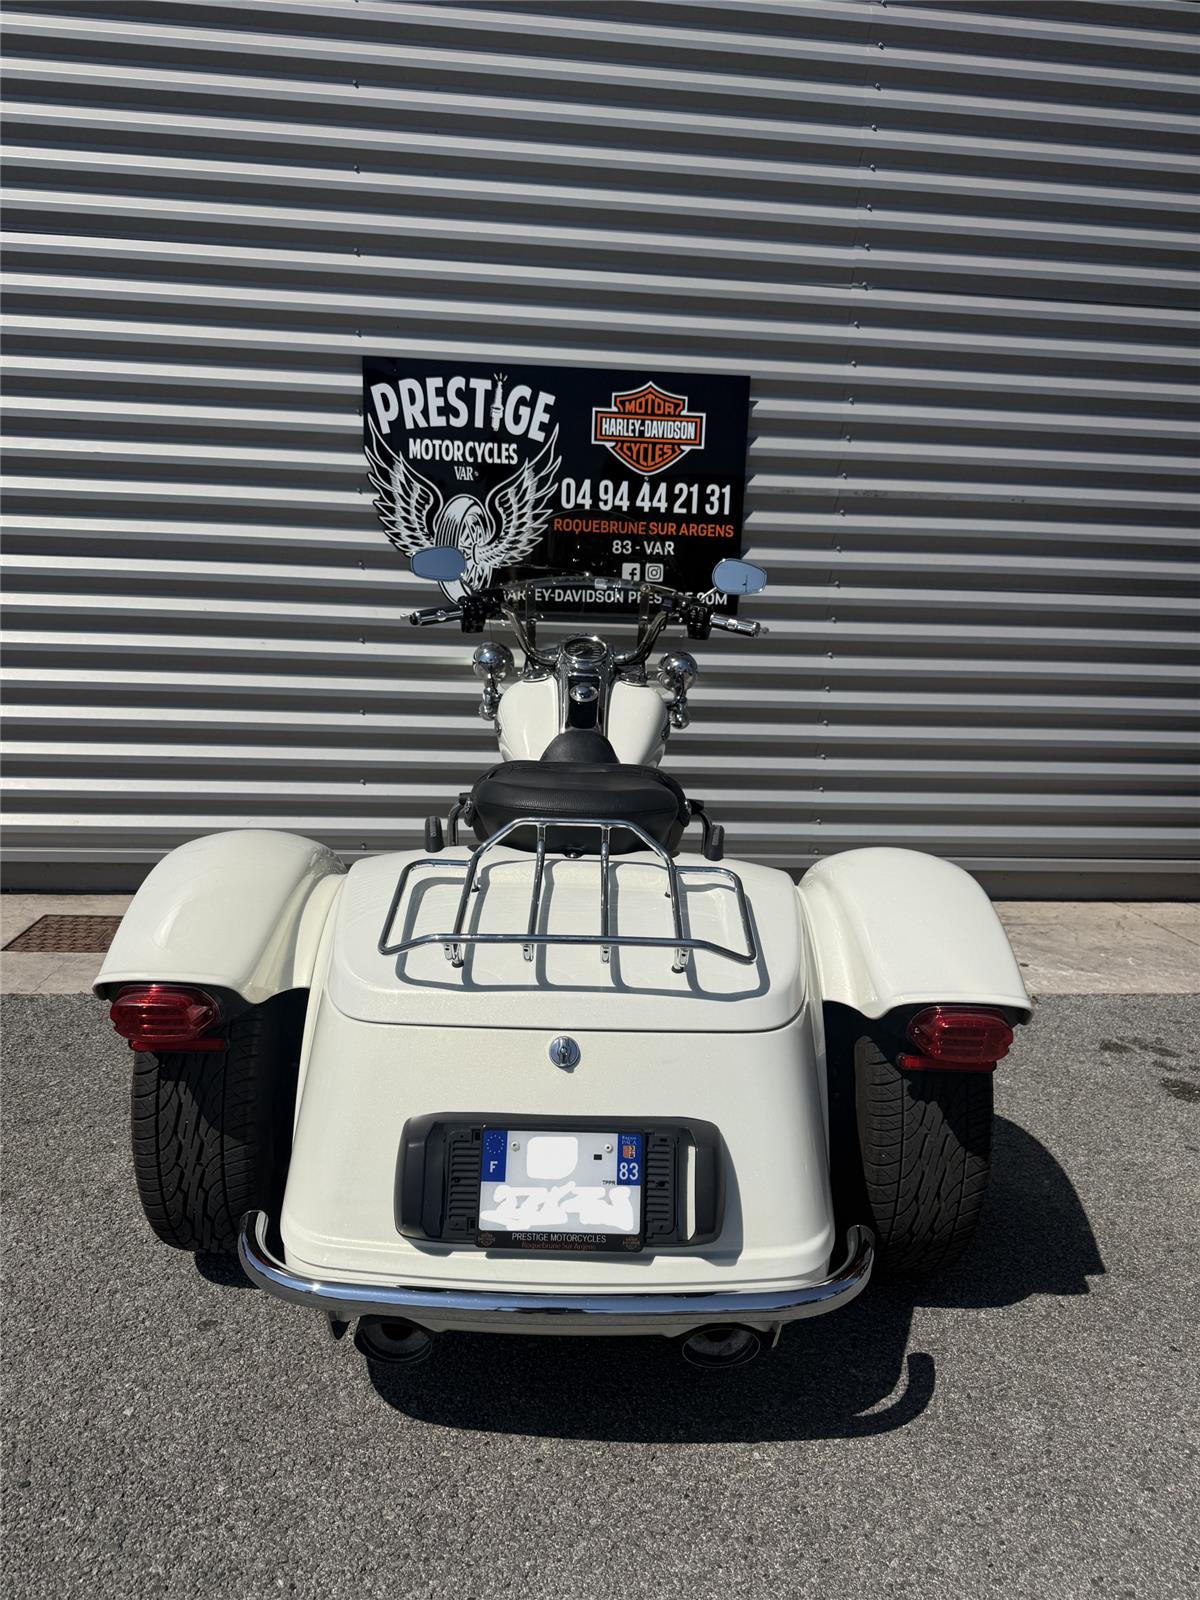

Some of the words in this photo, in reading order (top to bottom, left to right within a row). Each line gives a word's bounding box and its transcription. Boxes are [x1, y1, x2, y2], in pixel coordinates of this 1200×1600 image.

[370, 375, 556, 442] PRESTIGE
[624, 394, 675, 415] MOTOR
[602, 417, 696, 440] HARLEY-DAVIDSON
[408, 438, 518, 464] MOTORCYCLES
[622, 442, 673, 467] CYCLES
[454, 465, 474, 481] VAR
[561, 477, 592, 510] 04
[598, 479, 630, 512] 94
[635, 481, 668, 513] 44
[673, 482, 699, 514] 21
[705, 483, 731, 515] 31
[553, 518, 646, 535] ROQUEBRUNE
[649, 521, 677, 536] SUR
[679, 522, 735, 538] ARGENS
[612, 540, 632, 554] 83
[643, 541, 675, 556] VAR
[498, 588, 624, 603] AREY-DAVIDSON
[489, 1161, 498, 1173] F
[619, 1162, 639, 1180] 83
[511, 1232, 549, 1242] PRESTIGE
[550, 1234, 607, 1244] MOTORCYCLES
